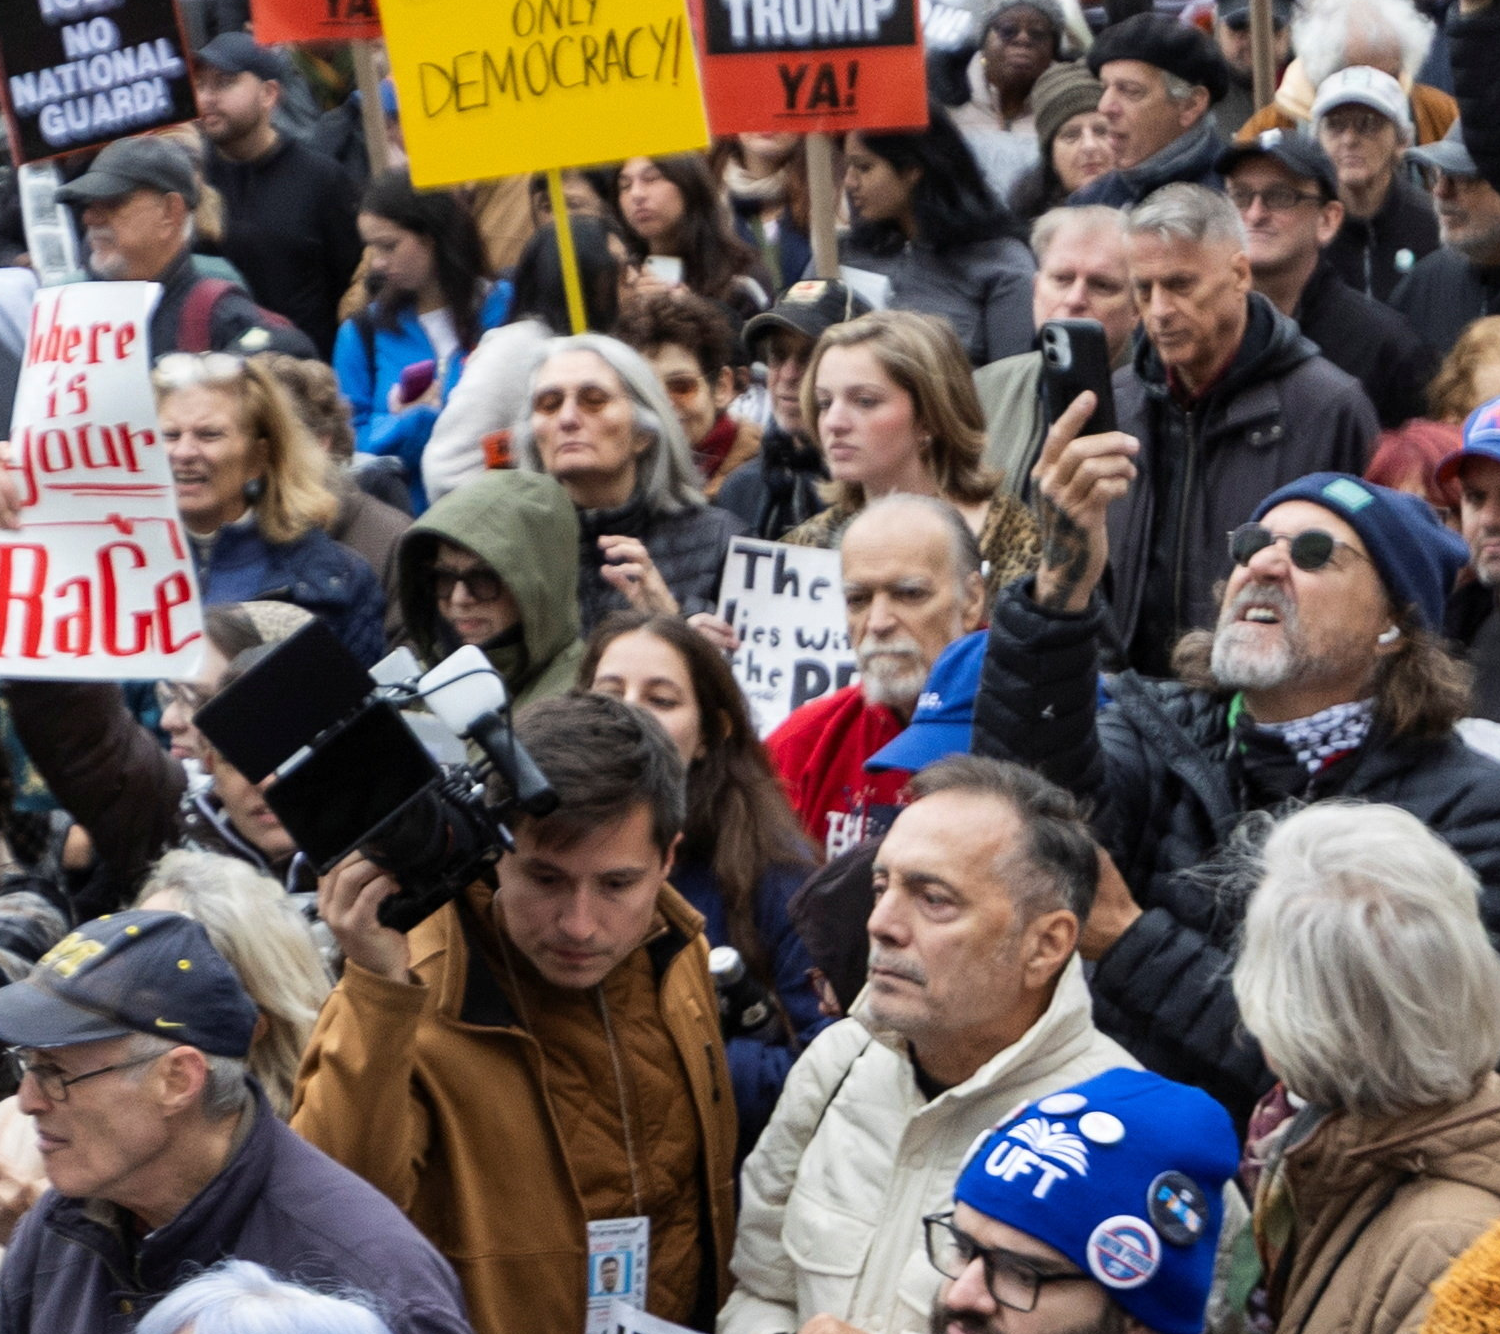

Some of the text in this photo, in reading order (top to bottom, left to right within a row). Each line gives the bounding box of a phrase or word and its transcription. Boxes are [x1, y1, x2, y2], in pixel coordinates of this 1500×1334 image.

[61, 15, 120, 60] NO
[418, 17, 684, 118] DEMOCRACY!
[9, 37, 183, 112] NATIONAL
[776, 61, 860, 110] YA!
[38, 80, 170, 142] GUARD!
[44, 365, 90, 419] is
[4, 421, 157, 509] your
[733, 544, 832, 602] The
[984, 1139, 1070, 1200] UFT
